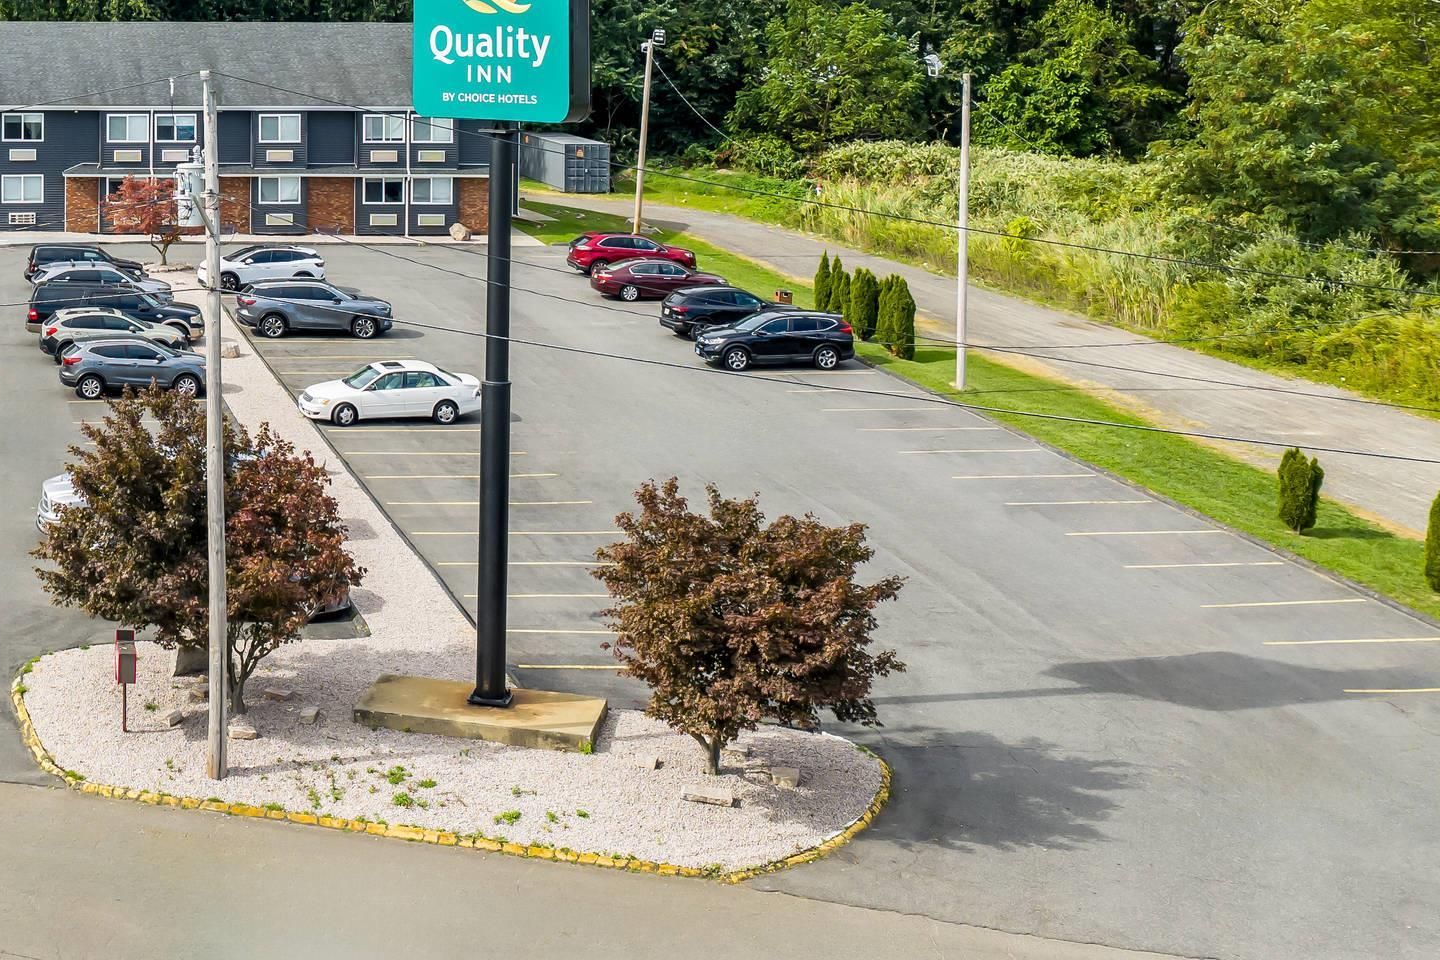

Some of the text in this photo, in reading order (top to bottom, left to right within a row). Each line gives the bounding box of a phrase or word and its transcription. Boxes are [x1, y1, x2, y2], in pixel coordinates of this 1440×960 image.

[430, 25, 551, 67] Quality
[467, 65, 512, 83] INN
[442, 92, 538, 105] BY CHOICE HOTELS
